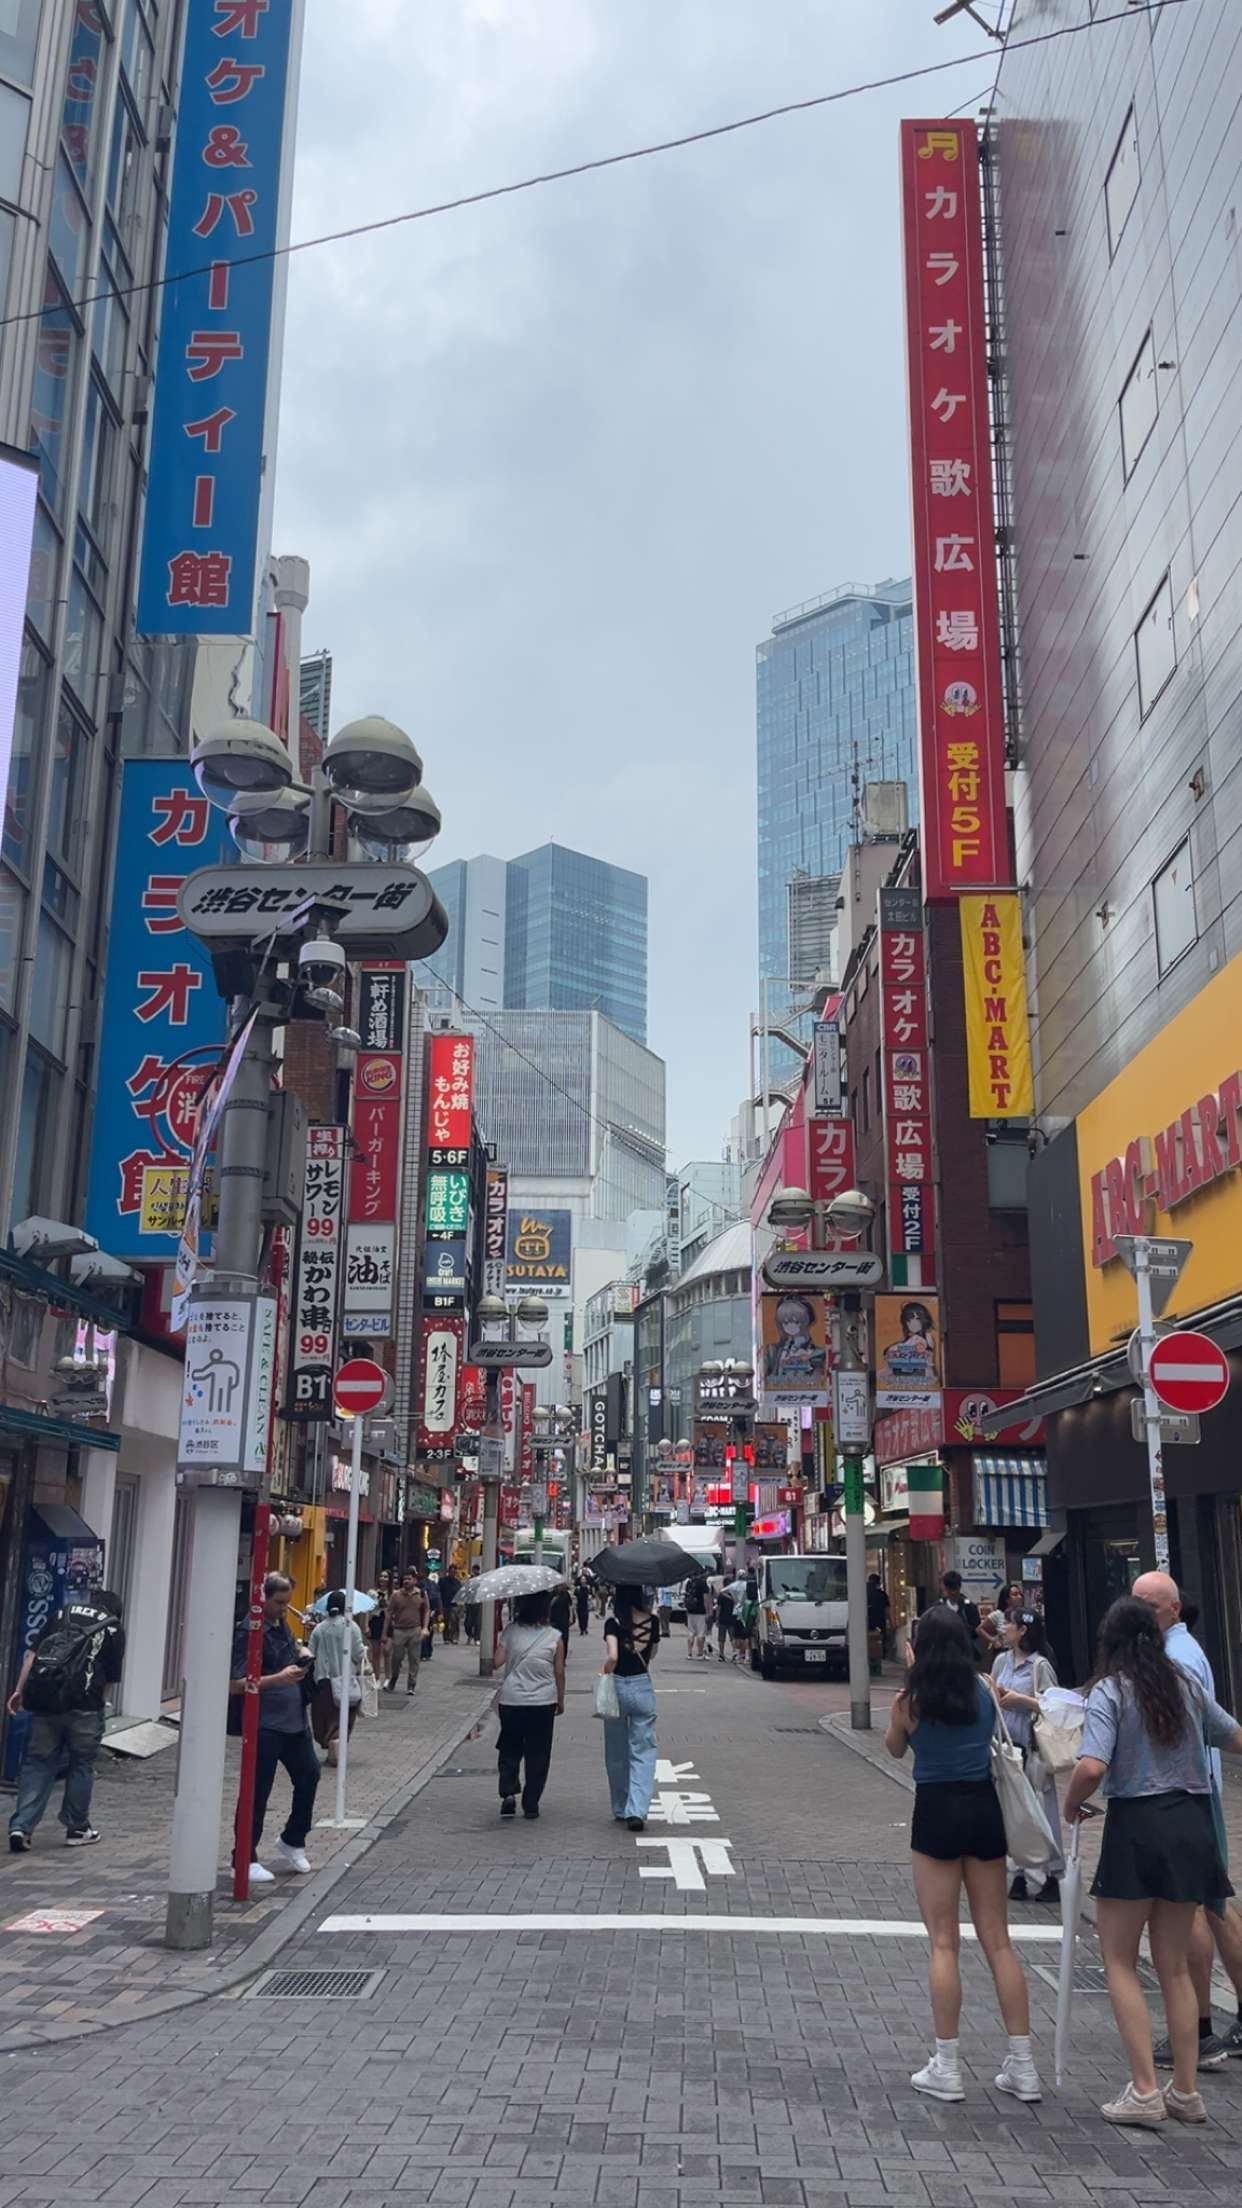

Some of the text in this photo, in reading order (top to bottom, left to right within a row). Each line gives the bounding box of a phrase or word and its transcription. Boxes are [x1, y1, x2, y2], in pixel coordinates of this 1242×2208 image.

[923, 185, 980, 652] カラオケ歌広場
[946, 741, 982, 868] 受付5F
[191, 881, 418, 916] 渋谷センター街
[367, 975, 390, 1049] 一軒め酒場
[450, 1042, 471, 1110] お好み焼
[890, 934, 925, 1182] カラオケ 歌広場
[433, 1076, 451, 1142] もんじゃ
[364, 1107, 386, 1215] バーガーキング
[305, 1163, 324, 1216] サワー
[323, 1160, 339, 1216] レモン
[429, 1174, 448, 1223] 無呼吸
[449, 1175, 467, 1223] いびき
[307, 1218, 334, 1236] 99
[901, 1185, 921, 1251] 受付2F
[302, 1251, 335, 1265] 秘伝
[506, 1264, 567, 1278] SUTAYA
[773, 1261, 875, 1275] 渋谷センター街
[300, 1266, 331, 1331] かわ串
[434, 1296, 455, 1307] B1F
[300, 1334, 328, 1354] 99
[344, 1316, 390, 1332] センタービル
[296, 1374, 327, 1400] B1
[593, 1401, 606, 1467] GOTCHA
[962, 1558, 1005, 1570] LOCKER
[968, 1544, 995, 1556] COIN
